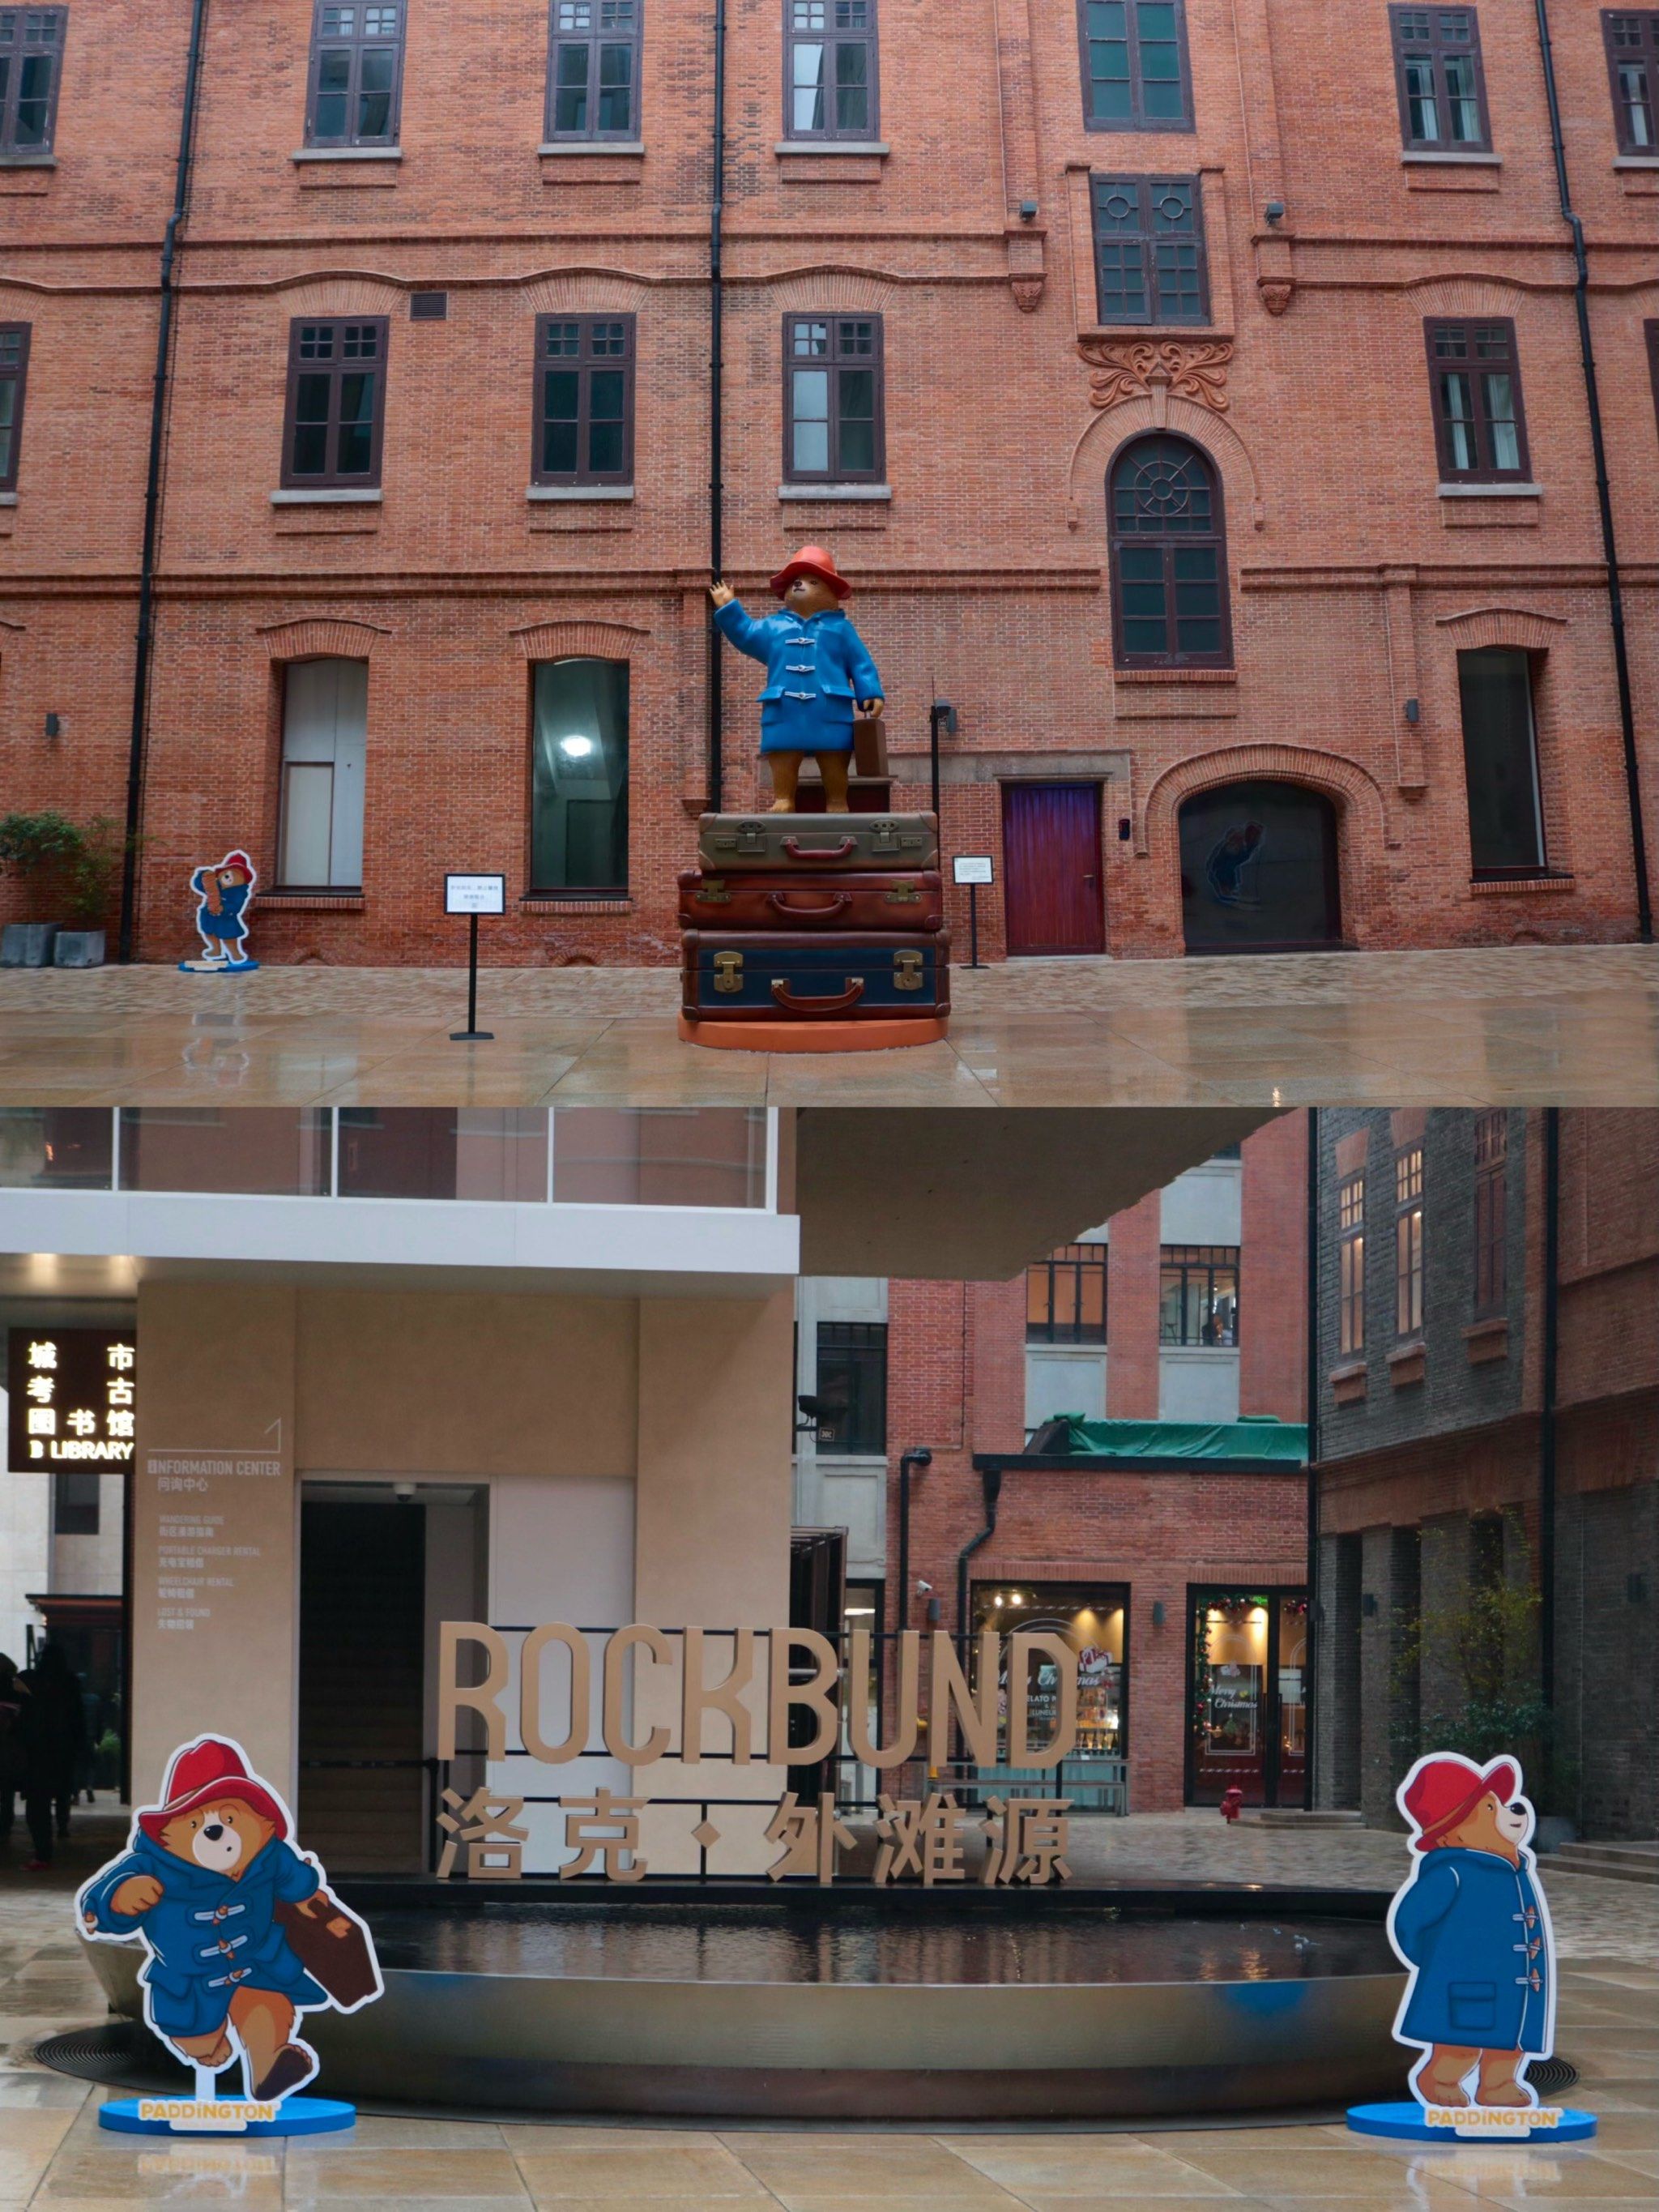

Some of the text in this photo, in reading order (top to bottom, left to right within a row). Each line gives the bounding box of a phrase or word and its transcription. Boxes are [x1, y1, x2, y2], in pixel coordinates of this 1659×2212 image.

[27, 1375, 135, 1404] 考古
[28, 1407, 135, 1437] 图书馆
[50, 1440, 134, 1459] LIBRARY
[237, 1461, 281, 1476] CENTER
[157, 1476, 209, 1492] 问询中心
[197, 1546, 232, 1556] CHARGER
[233, 1546, 261, 1557] RENTAL
[158, 1576, 234, 1587] WHEELCHAIR RENTAL
[157, 1607, 175, 1616] LOST
[186, 1608, 211, 1617] FOUND
[437, 1621, 1079, 1769] ROCKBUND
[1215, 1697, 1258, 1709] Christmas
